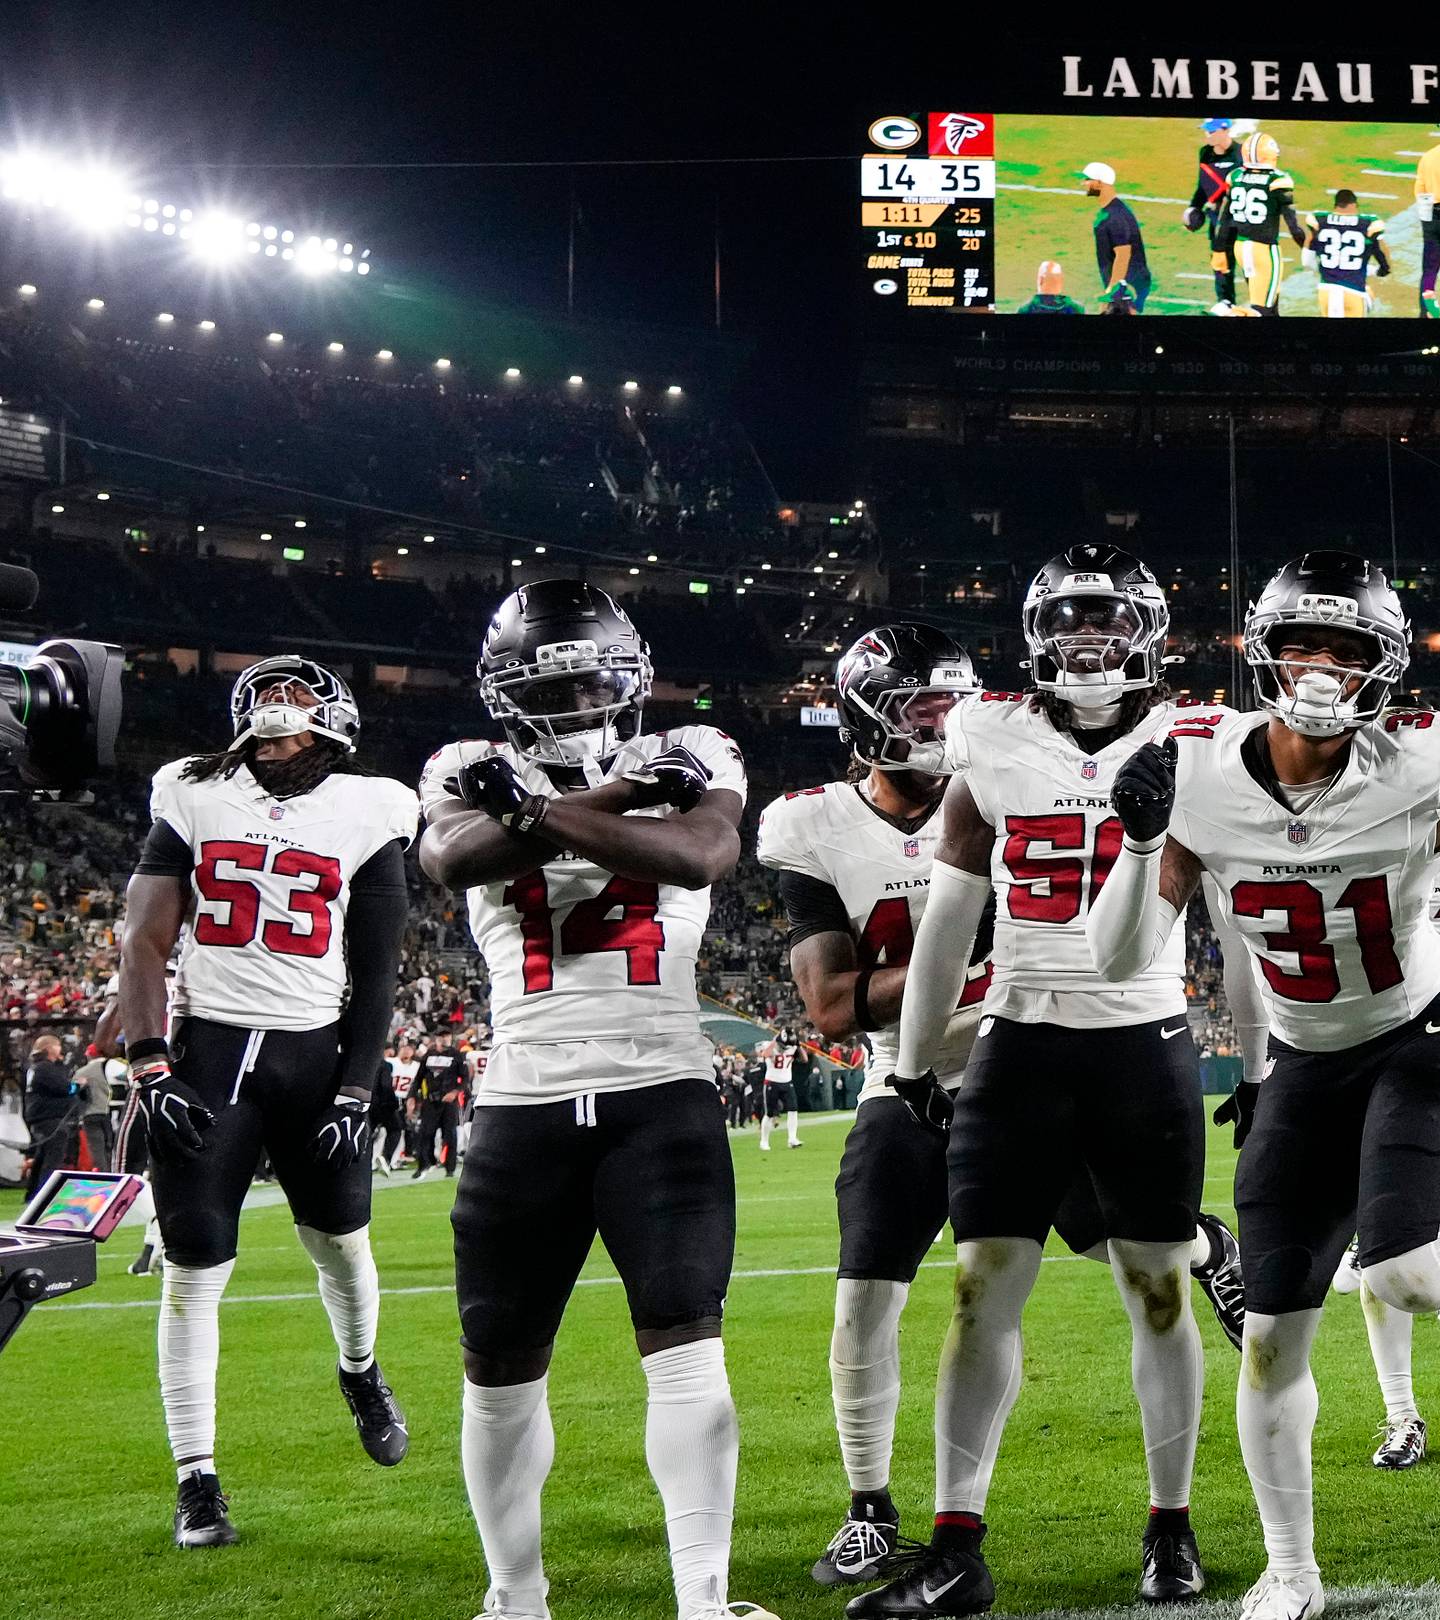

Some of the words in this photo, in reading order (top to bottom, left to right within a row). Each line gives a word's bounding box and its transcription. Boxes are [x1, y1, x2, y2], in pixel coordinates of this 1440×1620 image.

[1062, 55, 1374, 104] LAMBEAU
[878, 163, 916, 191] 14
[941, 165, 981, 191] 35
[1229, 186, 1268, 224] 26
[882, 206, 923, 223] 1:11
[954, 207, 981, 224] :25
[877, 230, 903, 248] 1ST
[915, 232, 936, 248] 10
[961, 238, 980, 250] 20
[1317, 228, 1366, 270] 32
[867, 255, 901, 269] GAME
[1074, 574, 1101, 583] ATL
[1317, 598, 1339, 607] ATL
[556, 644, 579, 653] ATL
[1053, 798, 1118, 809] ATLANT
[1262, 864, 1343, 875] ATLANTA
[885, 877, 931, 891] ATLAN
[194, 839, 343, 959] 53
[502, 867, 666, 996] 14
[1229, 873, 1405, 1003] 31
[774, 1055, 795, 1069] 87
